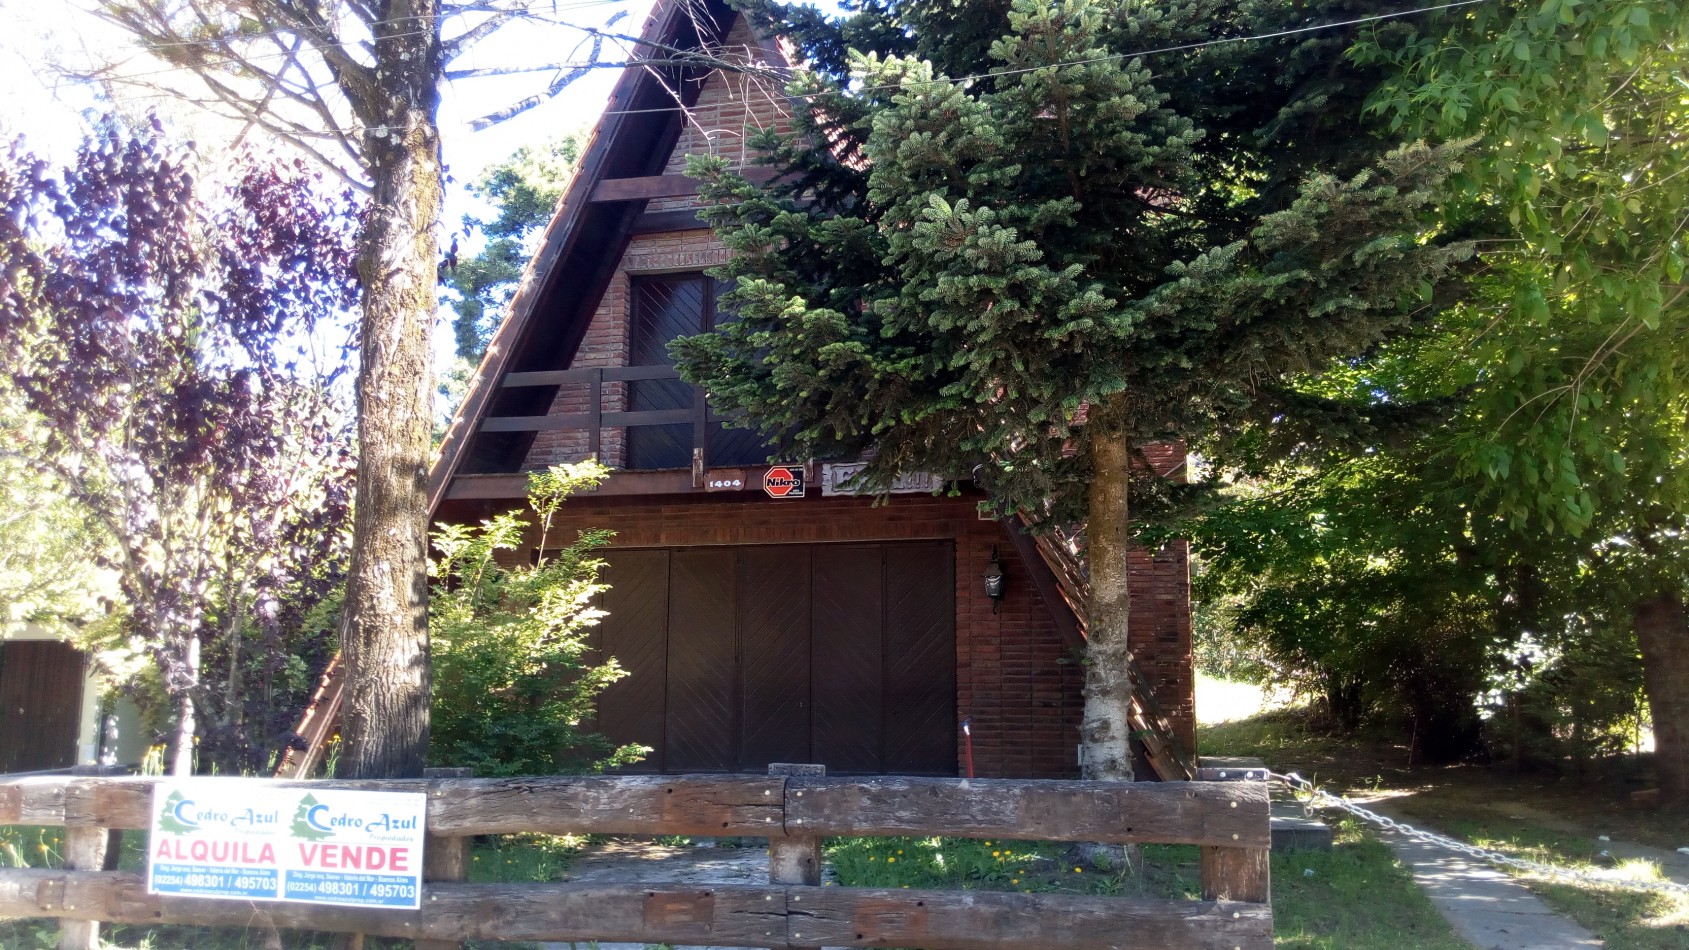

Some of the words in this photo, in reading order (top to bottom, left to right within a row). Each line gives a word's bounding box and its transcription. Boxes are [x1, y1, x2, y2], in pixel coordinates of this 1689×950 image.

[709, 479, 741, 488] 1404
[766, 477, 801, 488] Nikro
[174, 799, 228, 826] Cedro
[230, 808, 278, 827] Azul
[307, 804, 363, 831] Cedro
[365, 813, 417, 832] Azul
[369, 833, 414, 842] Propiedades
[156, 838, 276, 865] ALQUILA
[298, 842, 409, 872] VENDE
[154, 874, 183, 886] (02254)
[184, 873, 224, 888] 498301
[234, 876, 277, 890] 495703
[287, 881, 317, 894] (02254)
[318, 881, 359, 895] 498301
[369, 884, 415, 898] 495703
